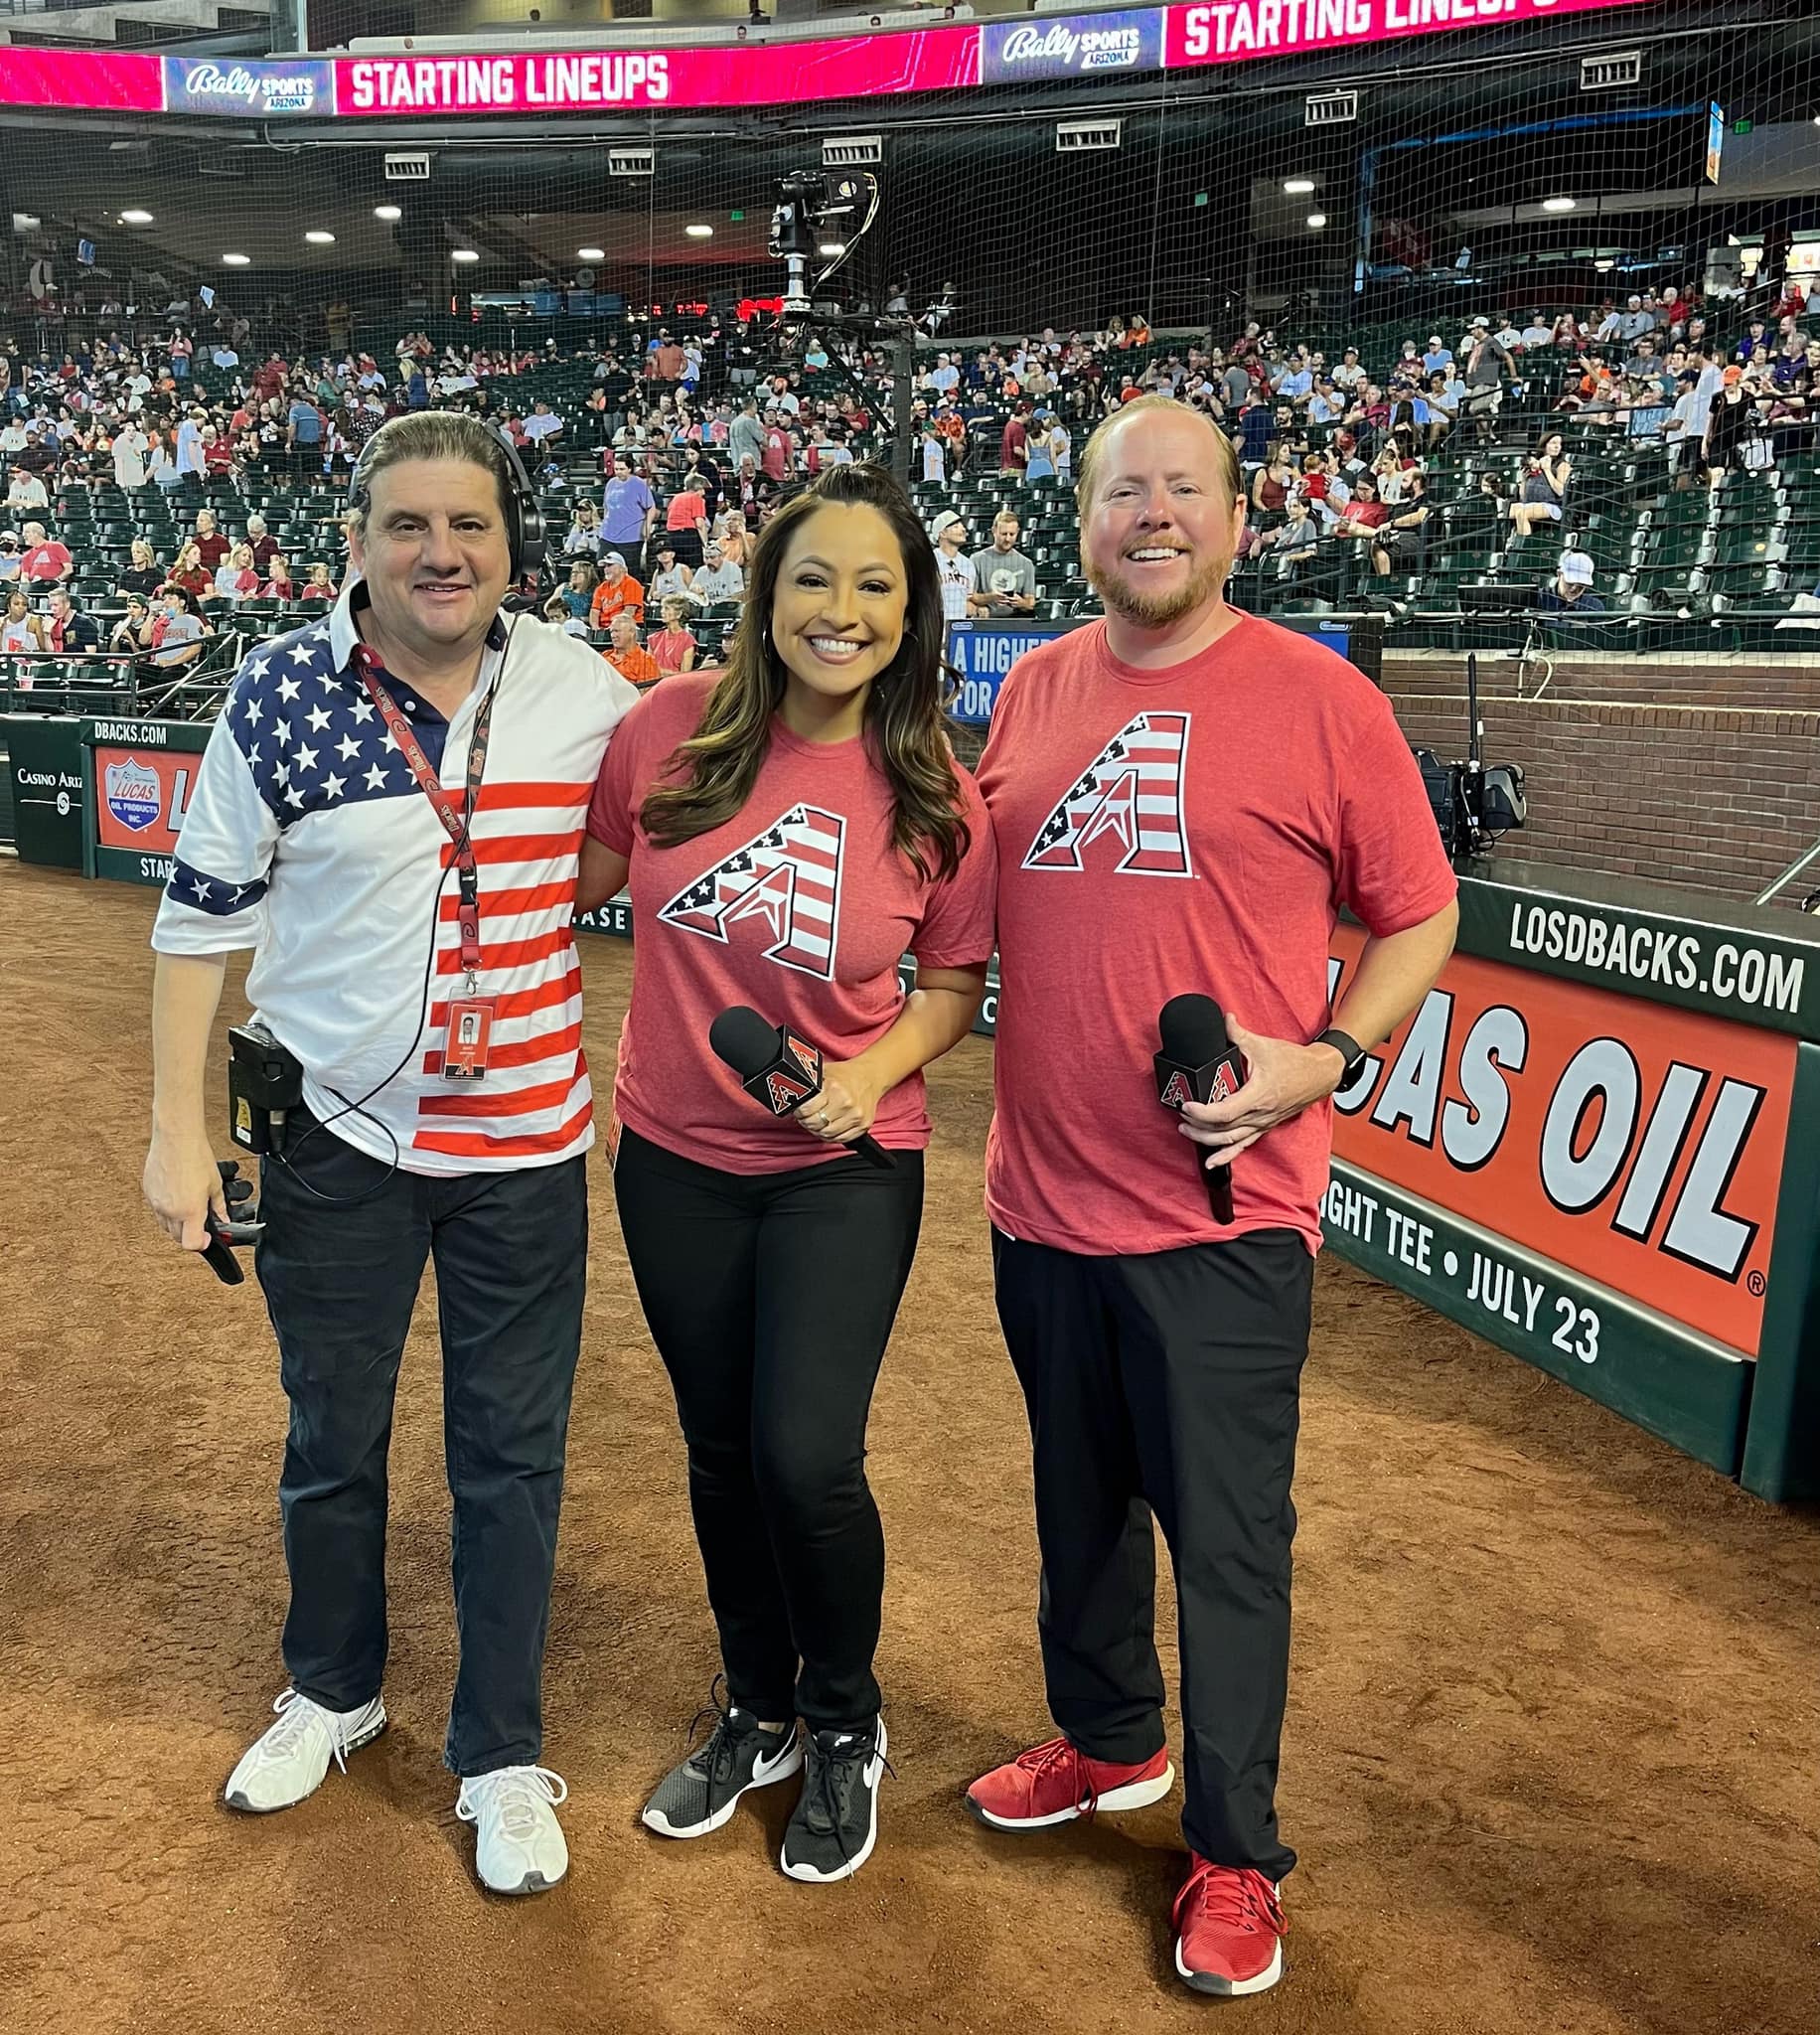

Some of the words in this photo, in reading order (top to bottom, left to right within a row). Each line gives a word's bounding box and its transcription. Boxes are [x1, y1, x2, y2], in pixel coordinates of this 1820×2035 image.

[1002, 24, 1080, 64] Bally
[1080, 29, 1139, 53] SPORTS
[186, 64, 260, 103] Bally
[261, 78, 314, 96] SPORTS
[353, 60, 514, 107] STARTING
[527, 55, 669, 103] LINEUPS
[954, 637, 968, 672] A
[94, 721, 167, 744] DBACKS.COM
[110, 801, 122, 811] OIL
[123, 803, 158, 815] PRODUCTS
[113, 780, 156, 800] LUCAS
[572, 906, 626, 930] ASE
[1510, 902, 1805, 1014] LOSDBACKS.COM
[1539, 1036, 1767, 1283] OIL
[1386, 1207, 1434, 1276] TEE
[1466, 1252, 1545, 1332] JULY
[1552, 1299, 1599, 1364] 23
